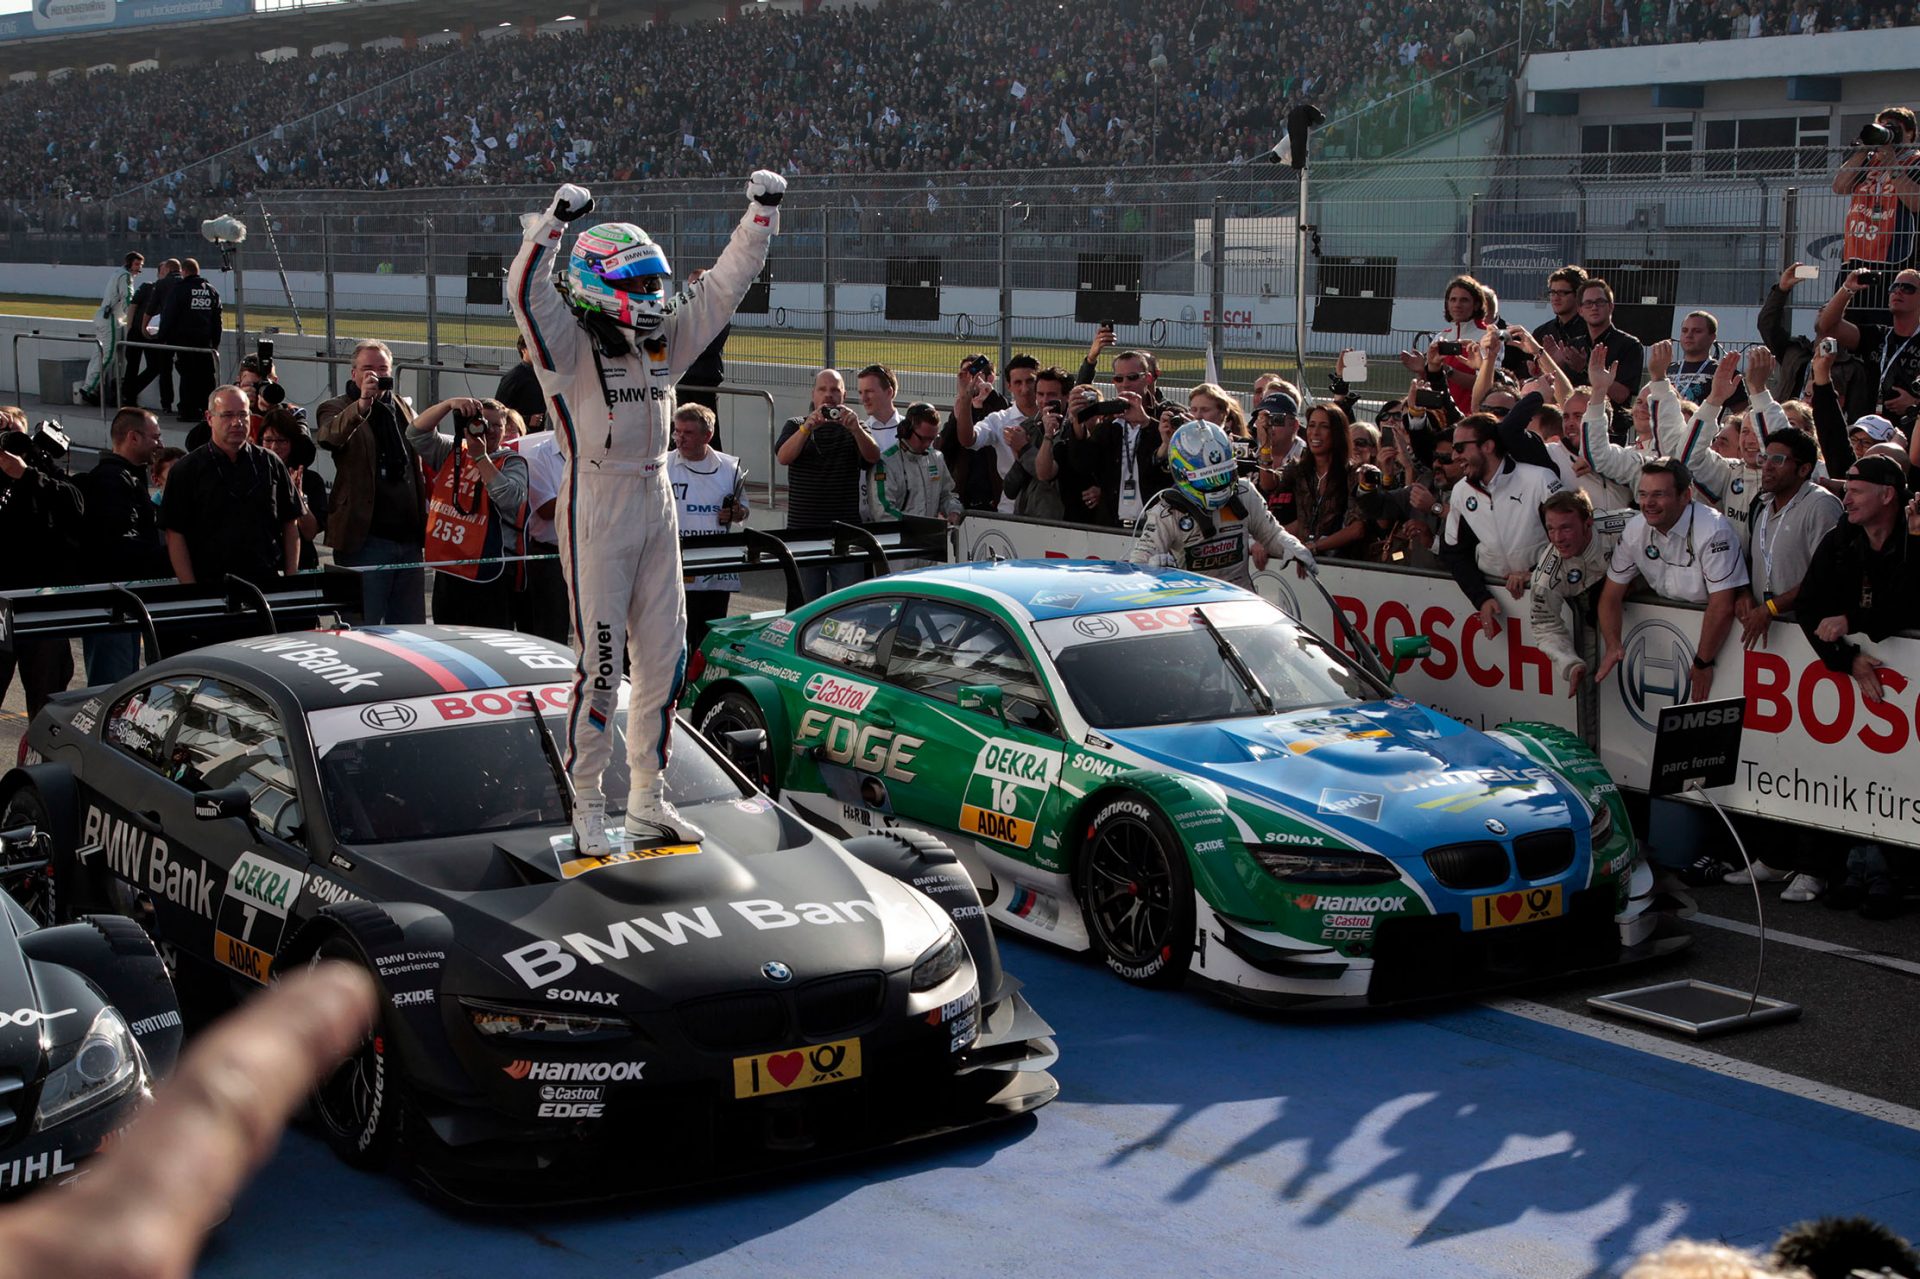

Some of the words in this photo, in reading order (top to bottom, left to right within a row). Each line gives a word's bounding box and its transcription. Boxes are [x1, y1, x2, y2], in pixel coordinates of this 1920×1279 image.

[190, 288, 210, 297] DTM
[191, 297, 212, 307] DSO
[608, 387, 648, 404] BMW
[686, 504, 722, 513] DMS
[431, 518, 466, 545] 253
[1202, 540, 1236, 555] Castrol
[760, 630, 789, 648] EDGE
[833, 621, 867, 647] FAR
[1333, 595, 1554, 695] BOSCH
[594, 621, 613, 690] Power
[278, 646, 384, 694] Bank
[758, 660, 782, 678] Castrol
[780, 666, 803, 684] EDGE
[430, 687, 572, 721] BOSC
[817, 680, 871, 712] Castrol
[70, 712, 96, 735] EDGE
[1662, 707, 1741, 733] DMSB
[794, 709, 926, 784] EDGE
[985, 744, 1050, 783] DEKRA
[1661, 760, 1689, 777] parc
[1691, 752, 1727, 769] fermé
[1384, 764, 1554, 794] ultimate
[1743, 760, 1861, 814] Technik
[989, 781, 1018, 815] 16
[976, 810, 1018, 844] ADAC
[1180, 818, 1223, 829] Experience
[1195, 839, 1225, 853] EXIDE
[1264, 832, 1325, 848] SONAX
[83, 803, 147, 883] BMW
[147, 837, 216, 920] Bank
[234, 860, 294, 910] DEKRA
[912, 876, 938, 886] BMW
[241, 906, 259, 942] 1
[1334, 916, 1373, 928] Castrol
[502, 906, 726, 990] BMW
[727, 899, 885, 930] Ban
[1320, 929, 1374, 941] EDGE
[227, 939, 263, 979] ADAC
[376, 954, 405, 966] BMW
[406, 951, 446, 961] Driving
[380, 962, 440, 977] Experience
[394, 989, 435, 1005] EXIDE
[545, 988, 621, 1006] SONAX
[131, 1010, 182, 1036] SYNTIUM
[555, 1086, 600, 1101] Castrol
[537, 1103, 607, 1118] EDGE
[0, 1149, 75, 1189] TIHL
